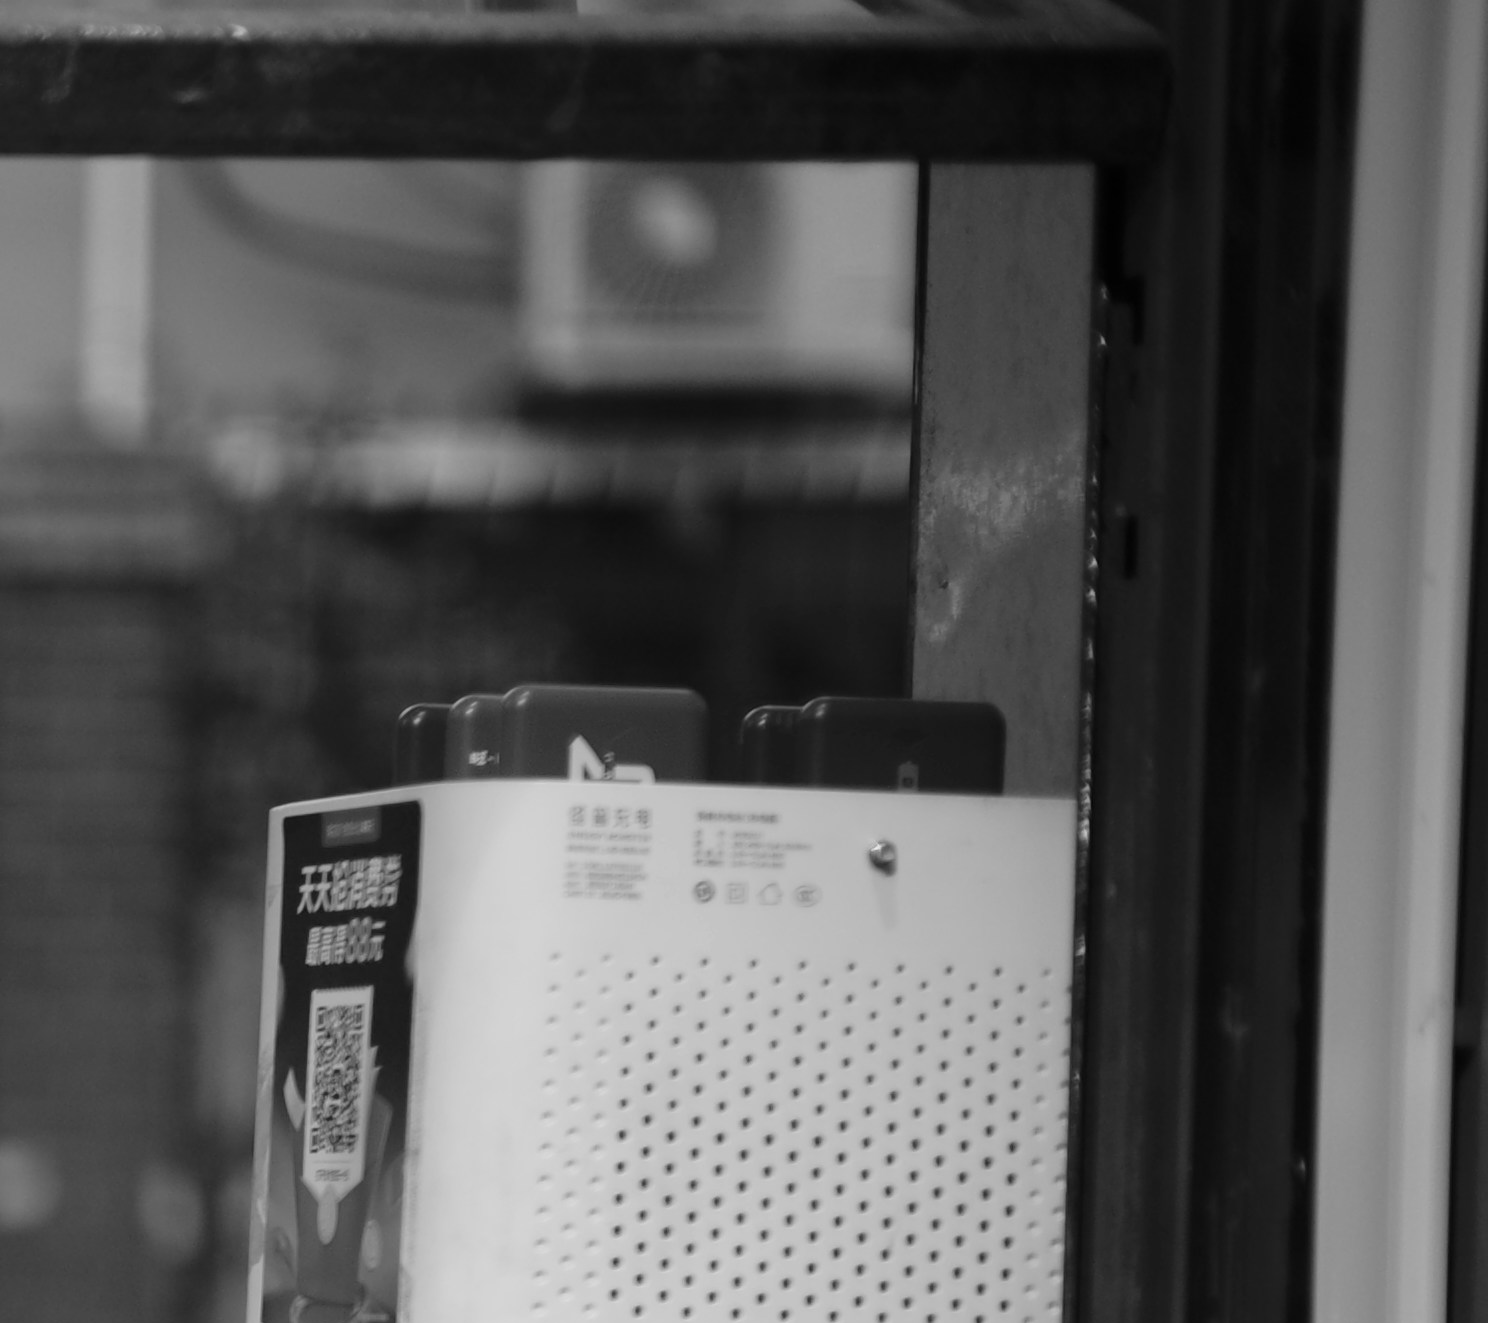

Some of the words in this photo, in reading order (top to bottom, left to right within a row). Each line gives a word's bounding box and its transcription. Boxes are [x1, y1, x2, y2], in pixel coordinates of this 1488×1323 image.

[296, 853, 403, 914] 天天抢消费券
[304, 916, 387, 966] 最高得88元
